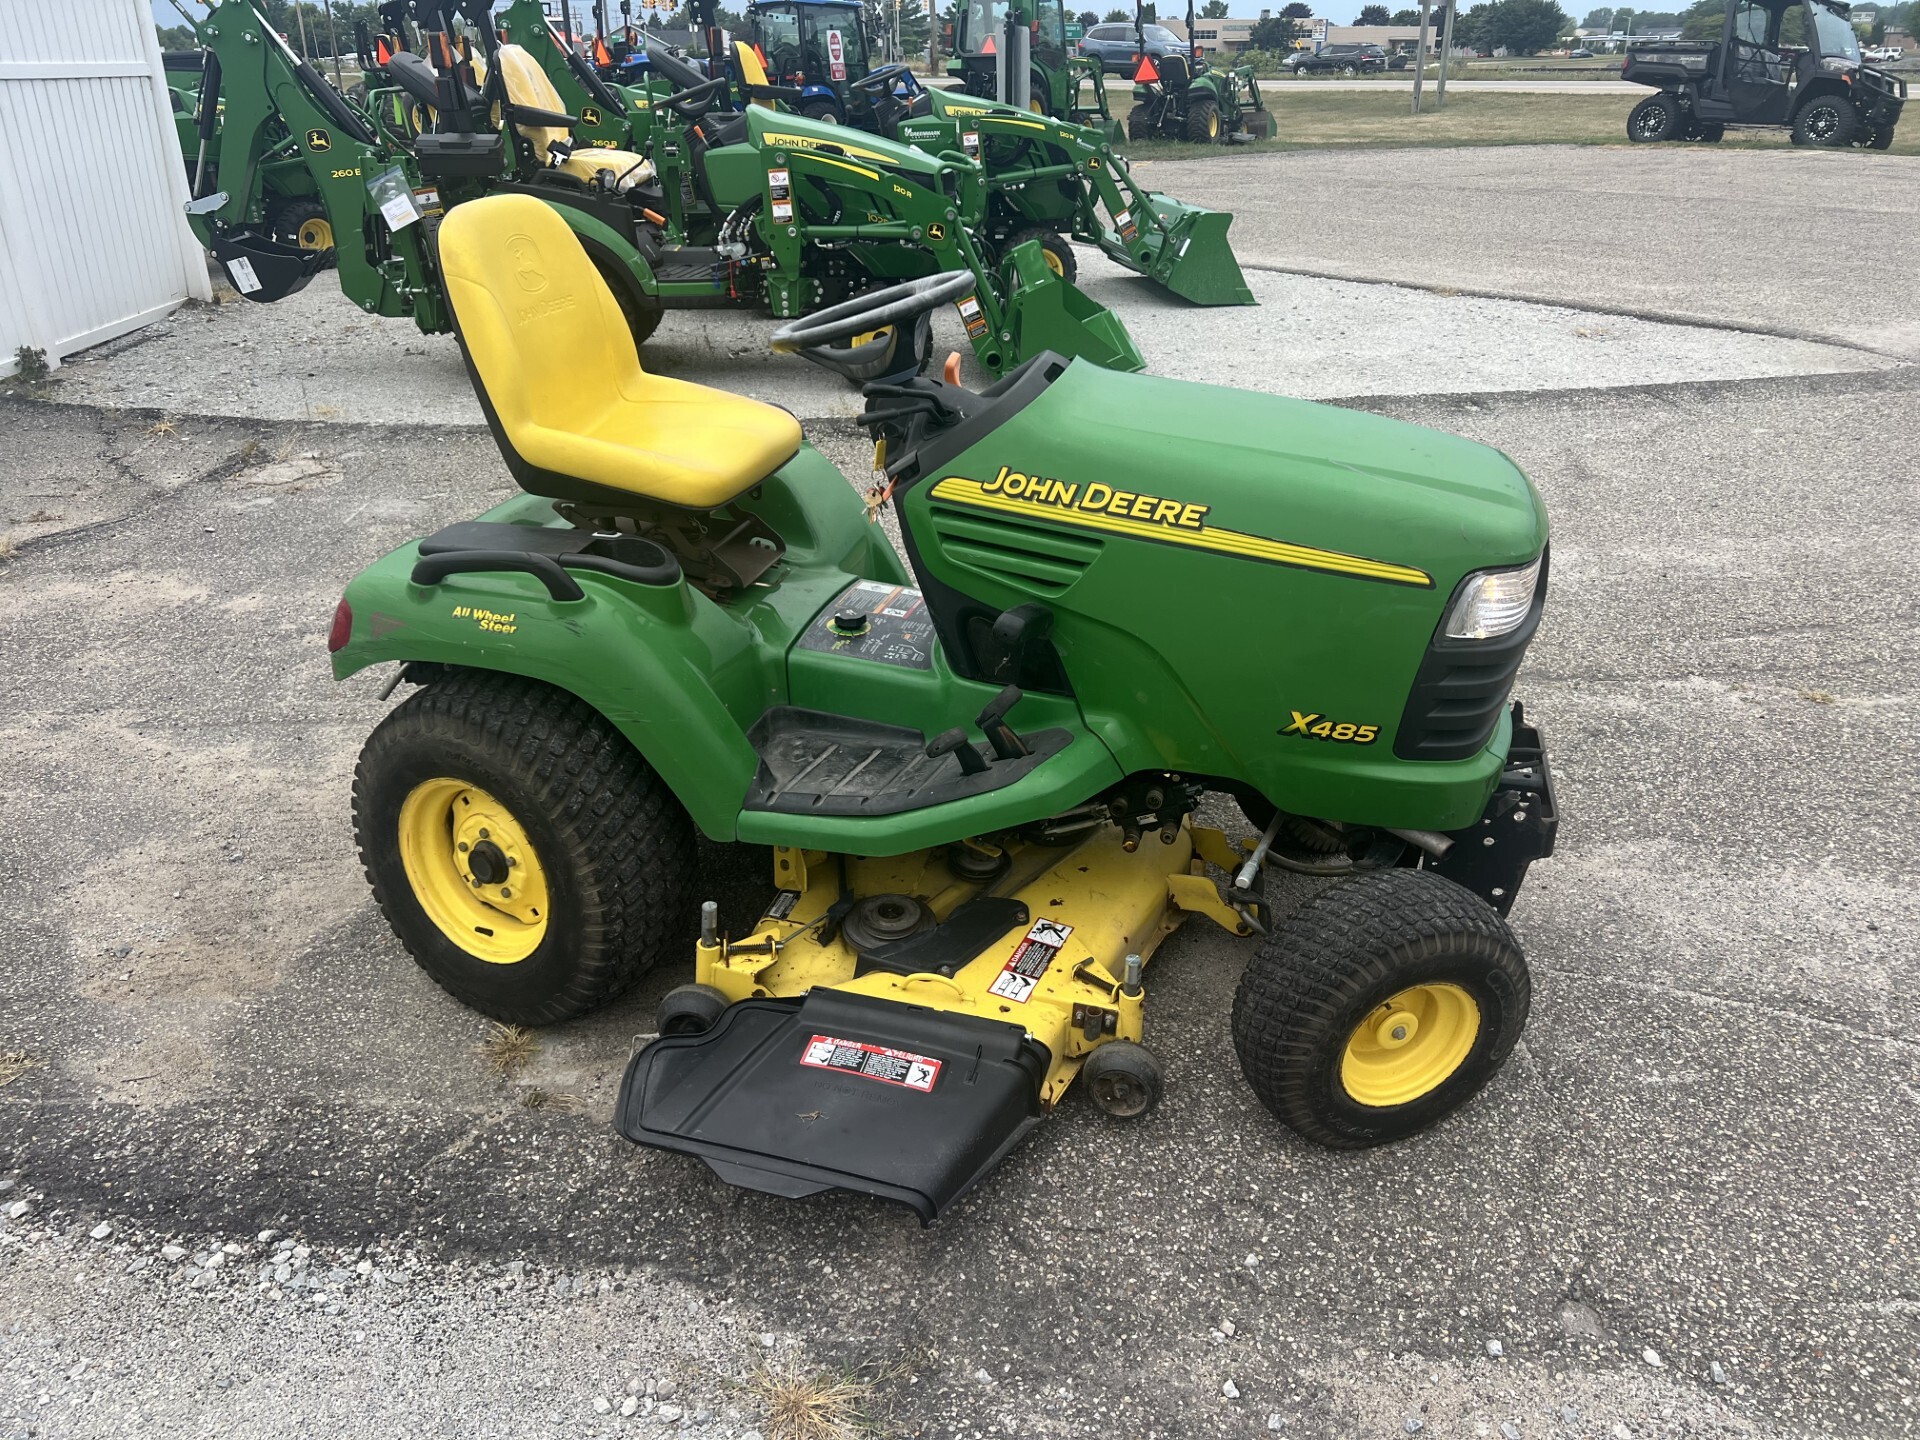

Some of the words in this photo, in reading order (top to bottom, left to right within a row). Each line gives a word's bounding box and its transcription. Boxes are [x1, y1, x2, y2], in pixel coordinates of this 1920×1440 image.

[772, 137, 798, 147] JOHN
[330, 169, 354, 178] 260
[517, 303, 542, 326] JOHN
[540, 294, 576, 316] DEERE
[982, 465, 1080, 507] JOHN
[1078, 481, 1211, 532] DEERE
[452, 606, 471, 618] All
[473, 608, 515, 623] Wheel
[479, 619, 517, 634] Steer
[1279, 710, 1380, 744] X485
